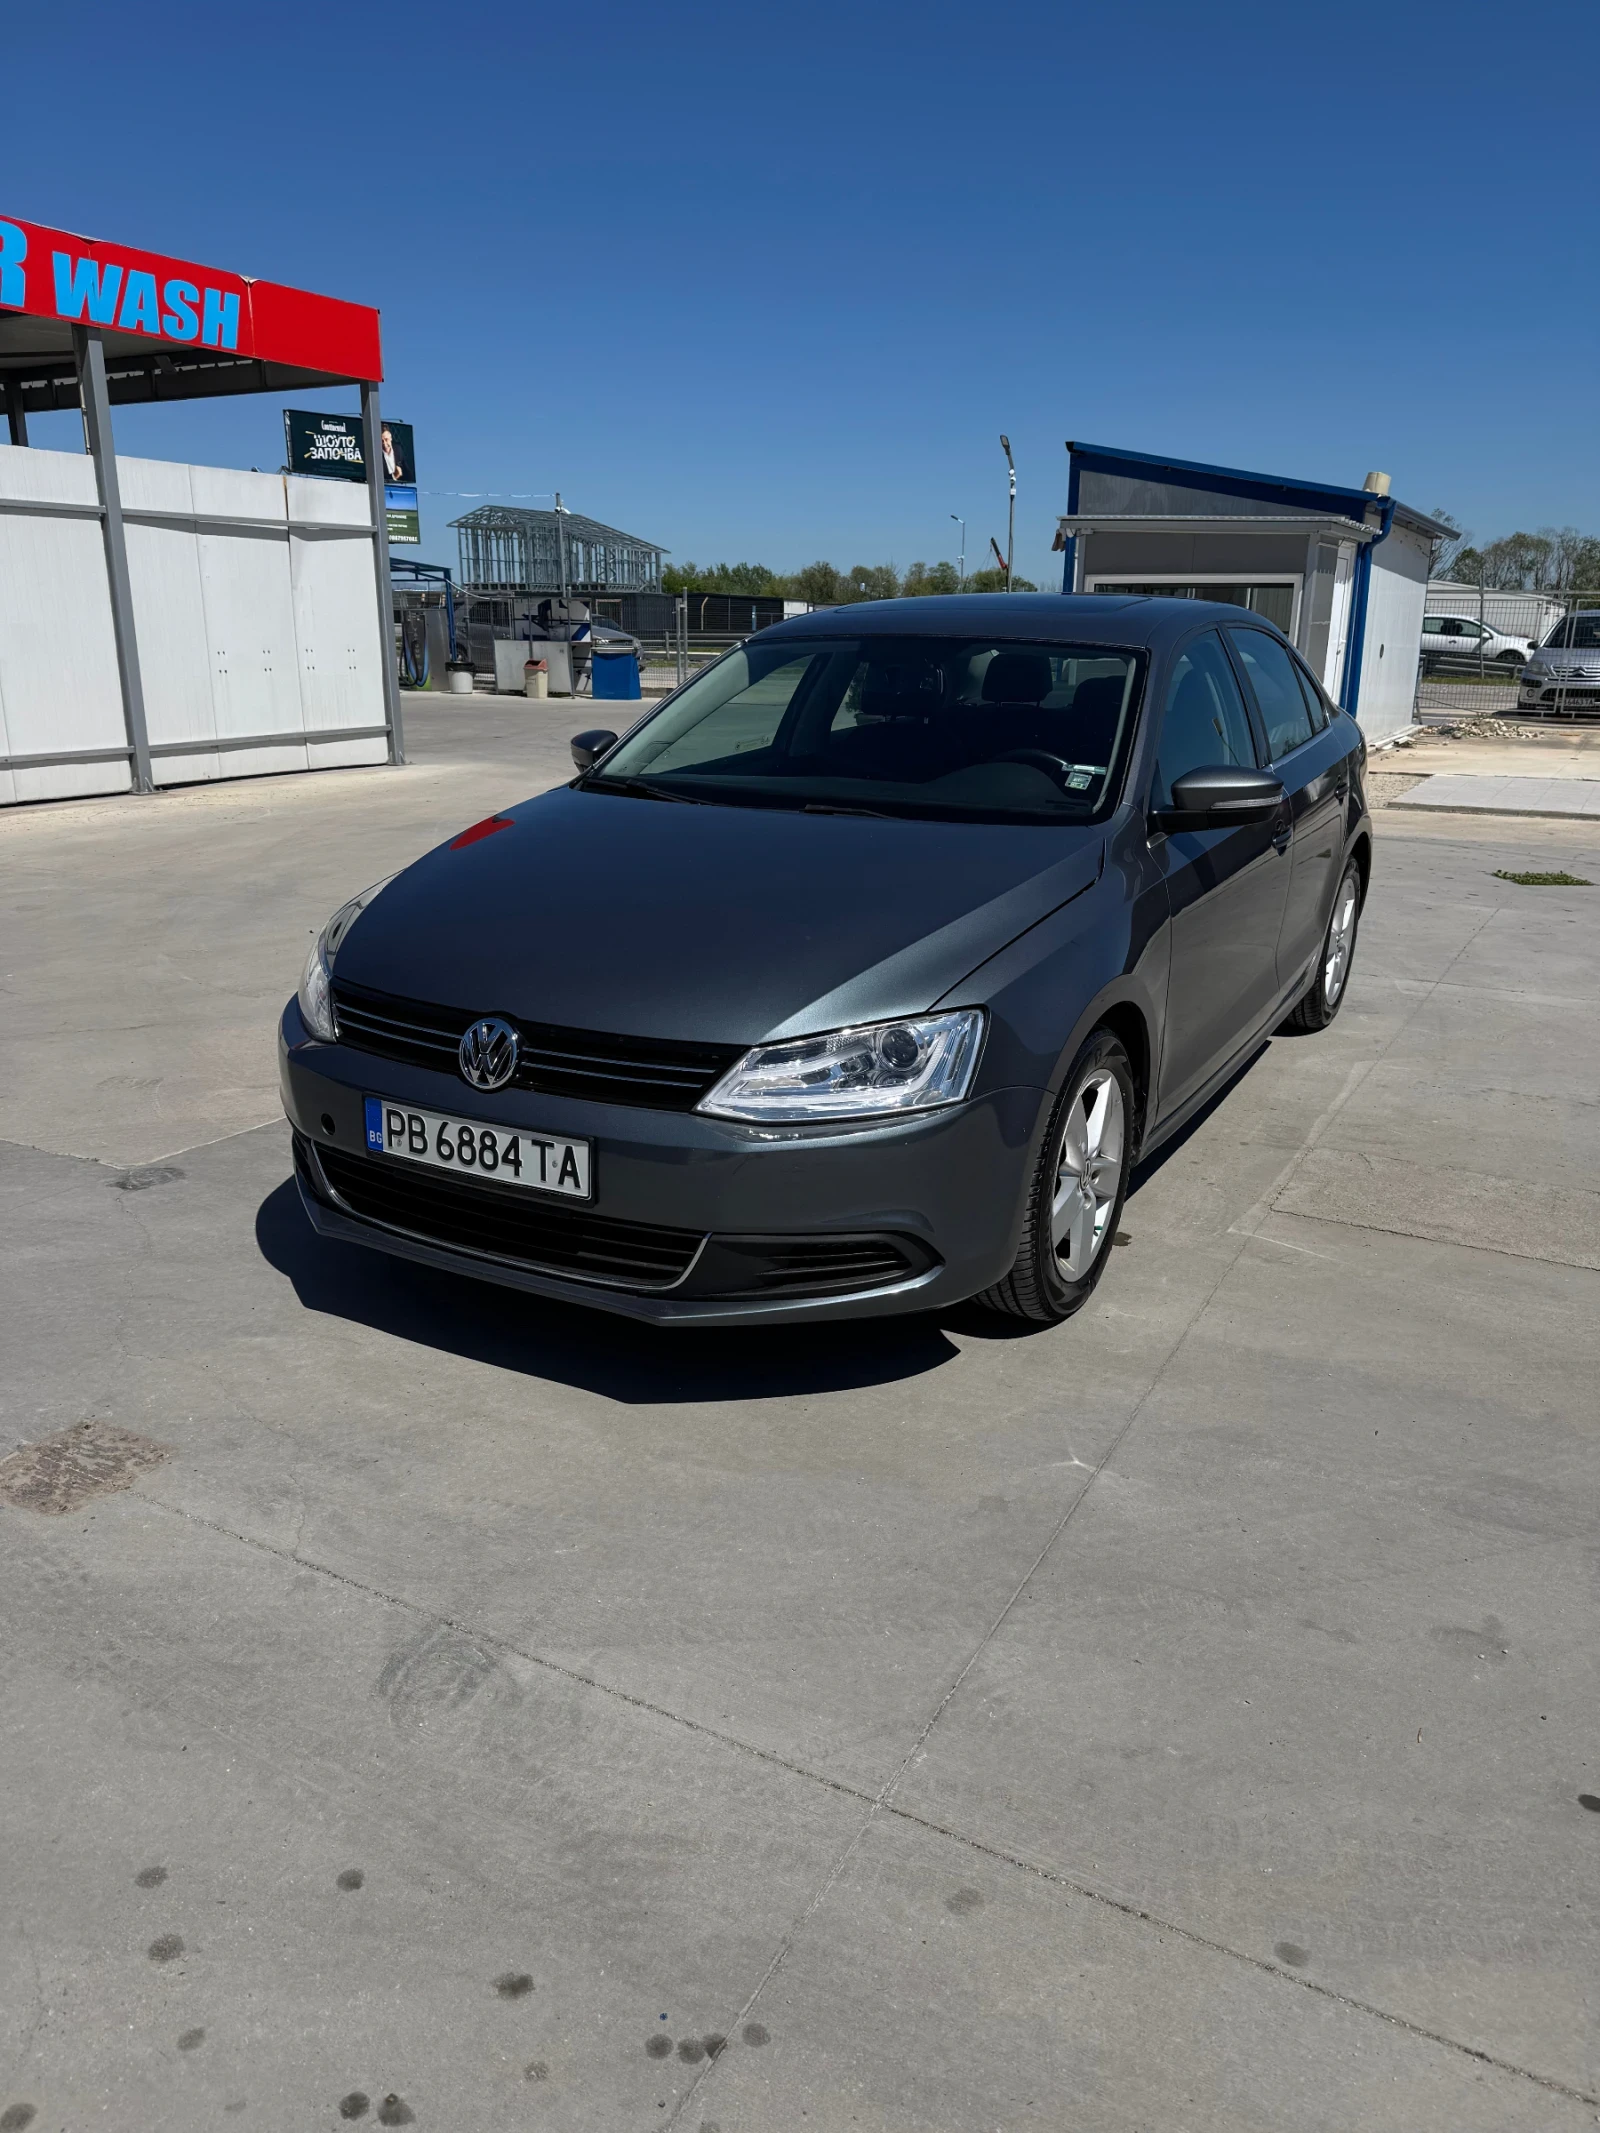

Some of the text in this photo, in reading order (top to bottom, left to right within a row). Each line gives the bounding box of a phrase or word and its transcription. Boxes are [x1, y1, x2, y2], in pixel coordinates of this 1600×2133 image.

[52, 251, 241, 349] WASH
[309, 447, 362, 461] ЗАПОЧВА
[369, 1130, 383, 1144] BG
[386, 1108, 582, 1189] PB 6884 TA
